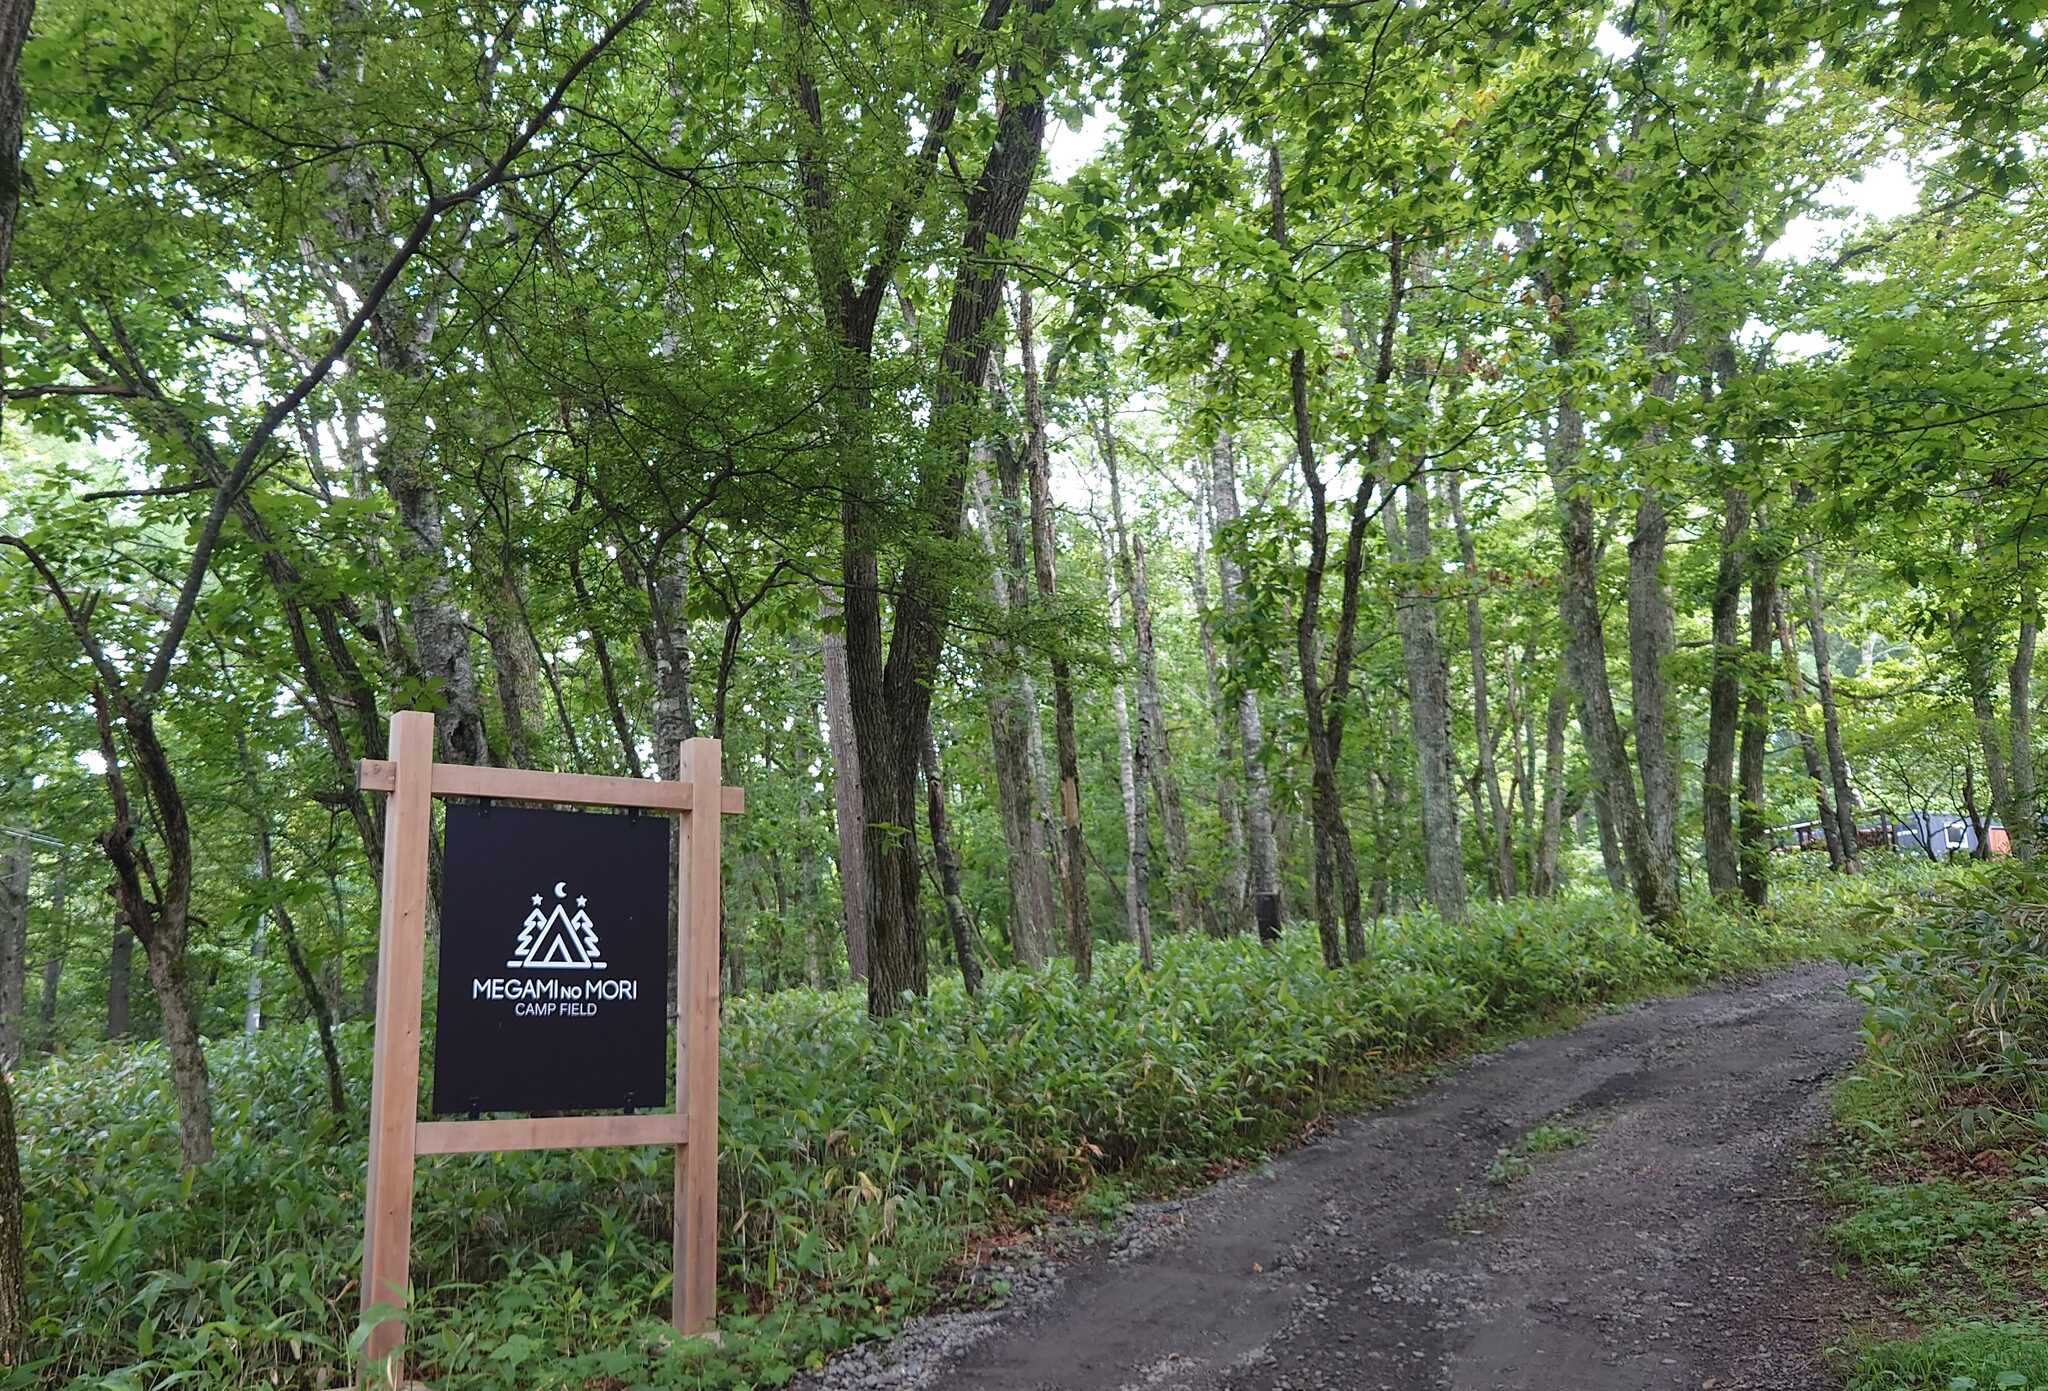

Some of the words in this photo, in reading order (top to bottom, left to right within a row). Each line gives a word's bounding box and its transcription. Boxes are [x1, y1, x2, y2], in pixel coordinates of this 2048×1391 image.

[472, 978, 559, 1000] MEGAMI
[560, 985, 583, 1000] NO
[585, 980, 637, 1000] MORI
[515, 1002, 557, 1016] CAMP
[559, 1003, 598, 1016] FIELD
